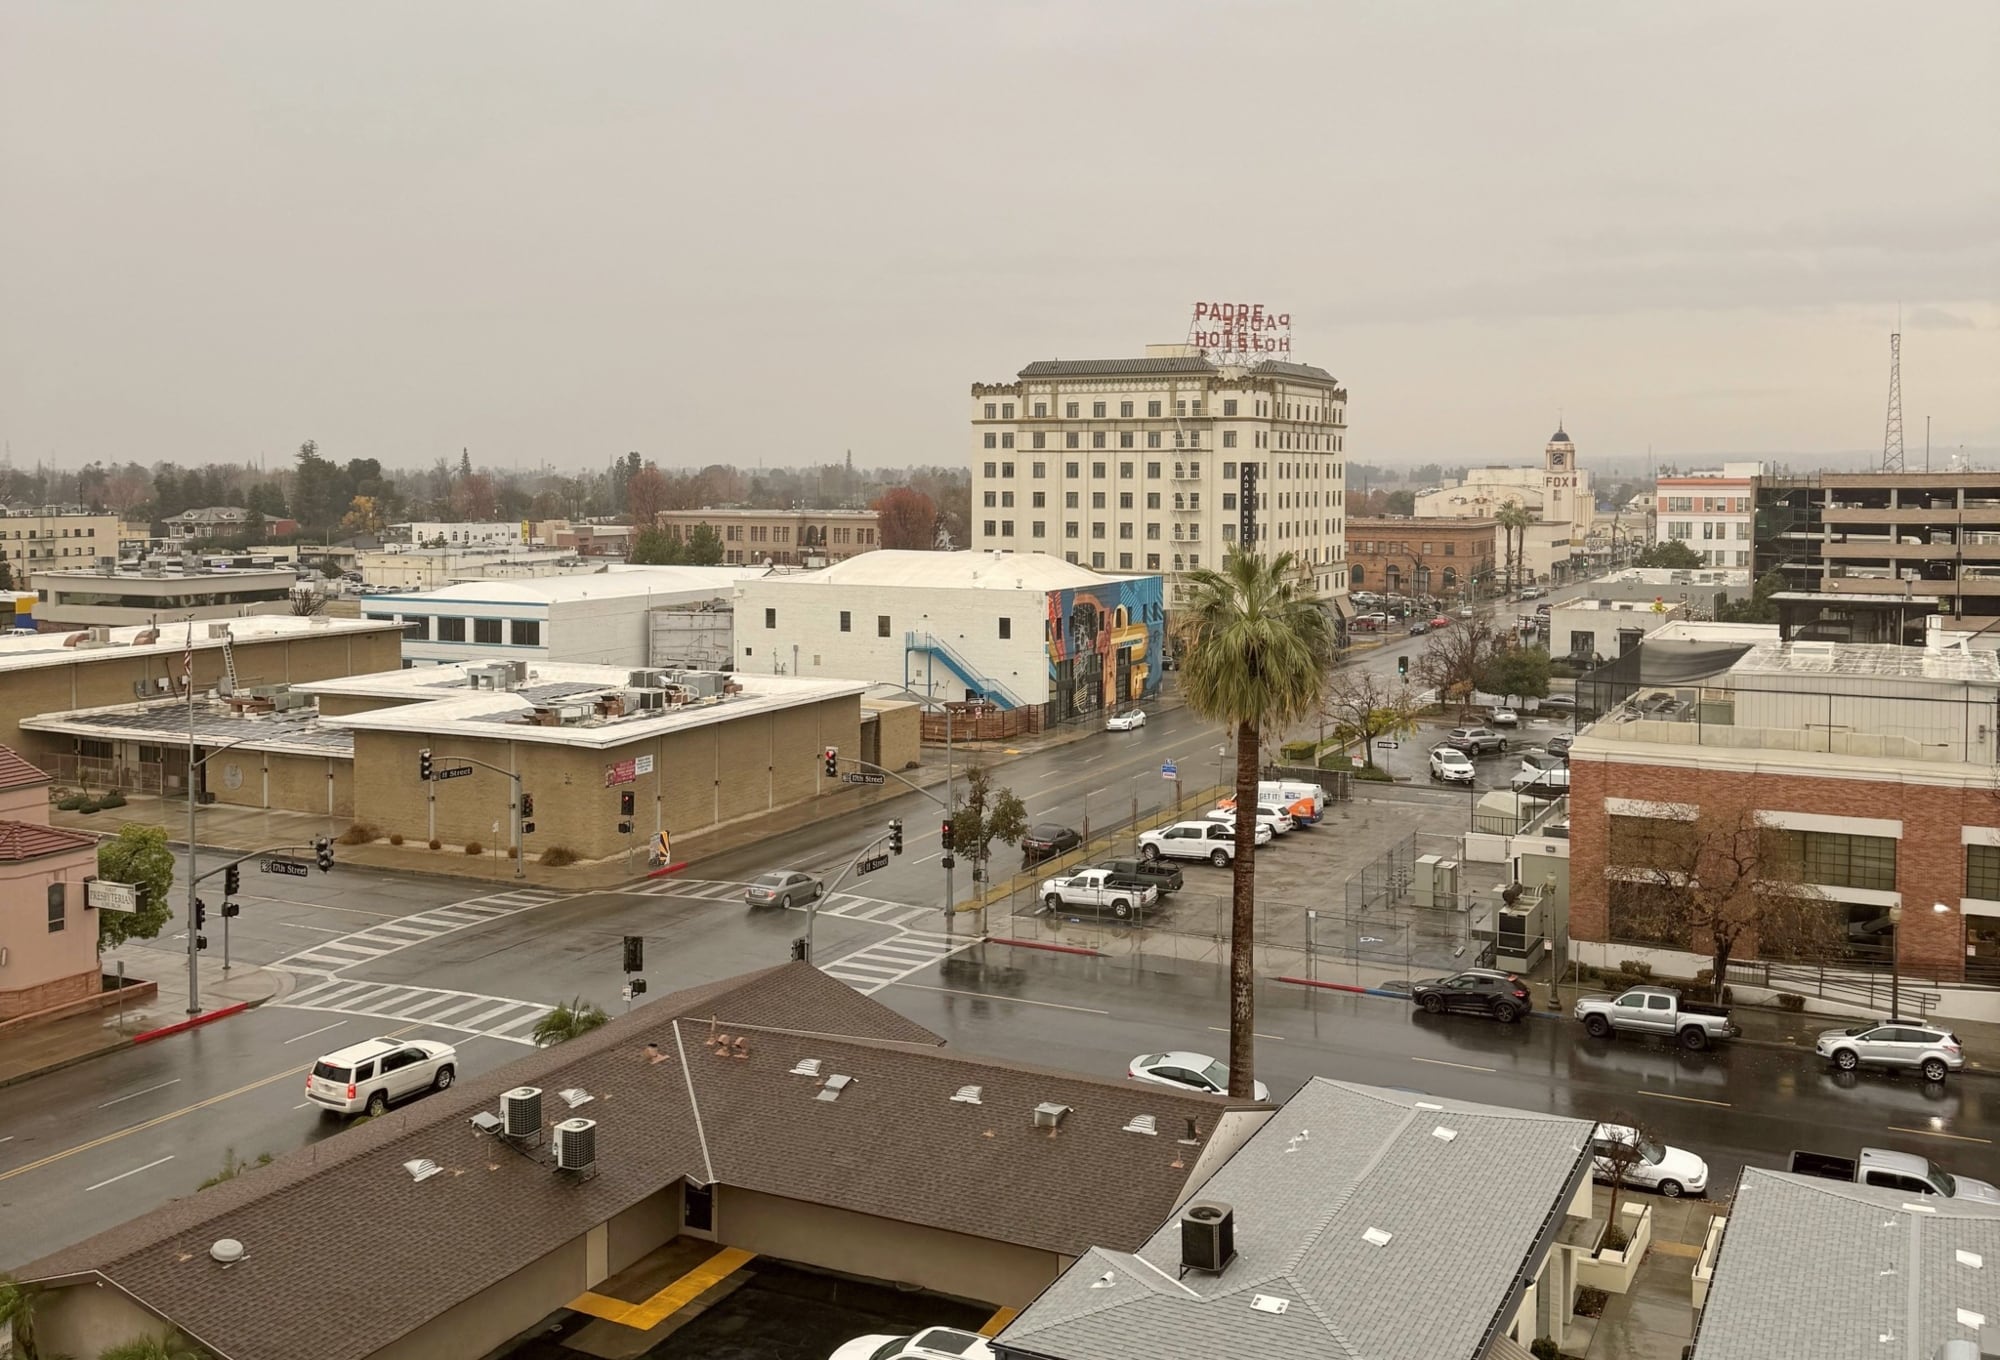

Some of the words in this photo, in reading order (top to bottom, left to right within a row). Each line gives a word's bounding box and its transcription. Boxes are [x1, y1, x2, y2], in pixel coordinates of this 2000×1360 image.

[1195, 302, 1264, 321] PADRE
[1195, 331, 1264, 348] HOTEL
[1546, 476, 1569, 488] FOX
[449, 767, 471, 777] Street
[872, 857, 888, 869] Street
[287, 865, 307, 875] Street
